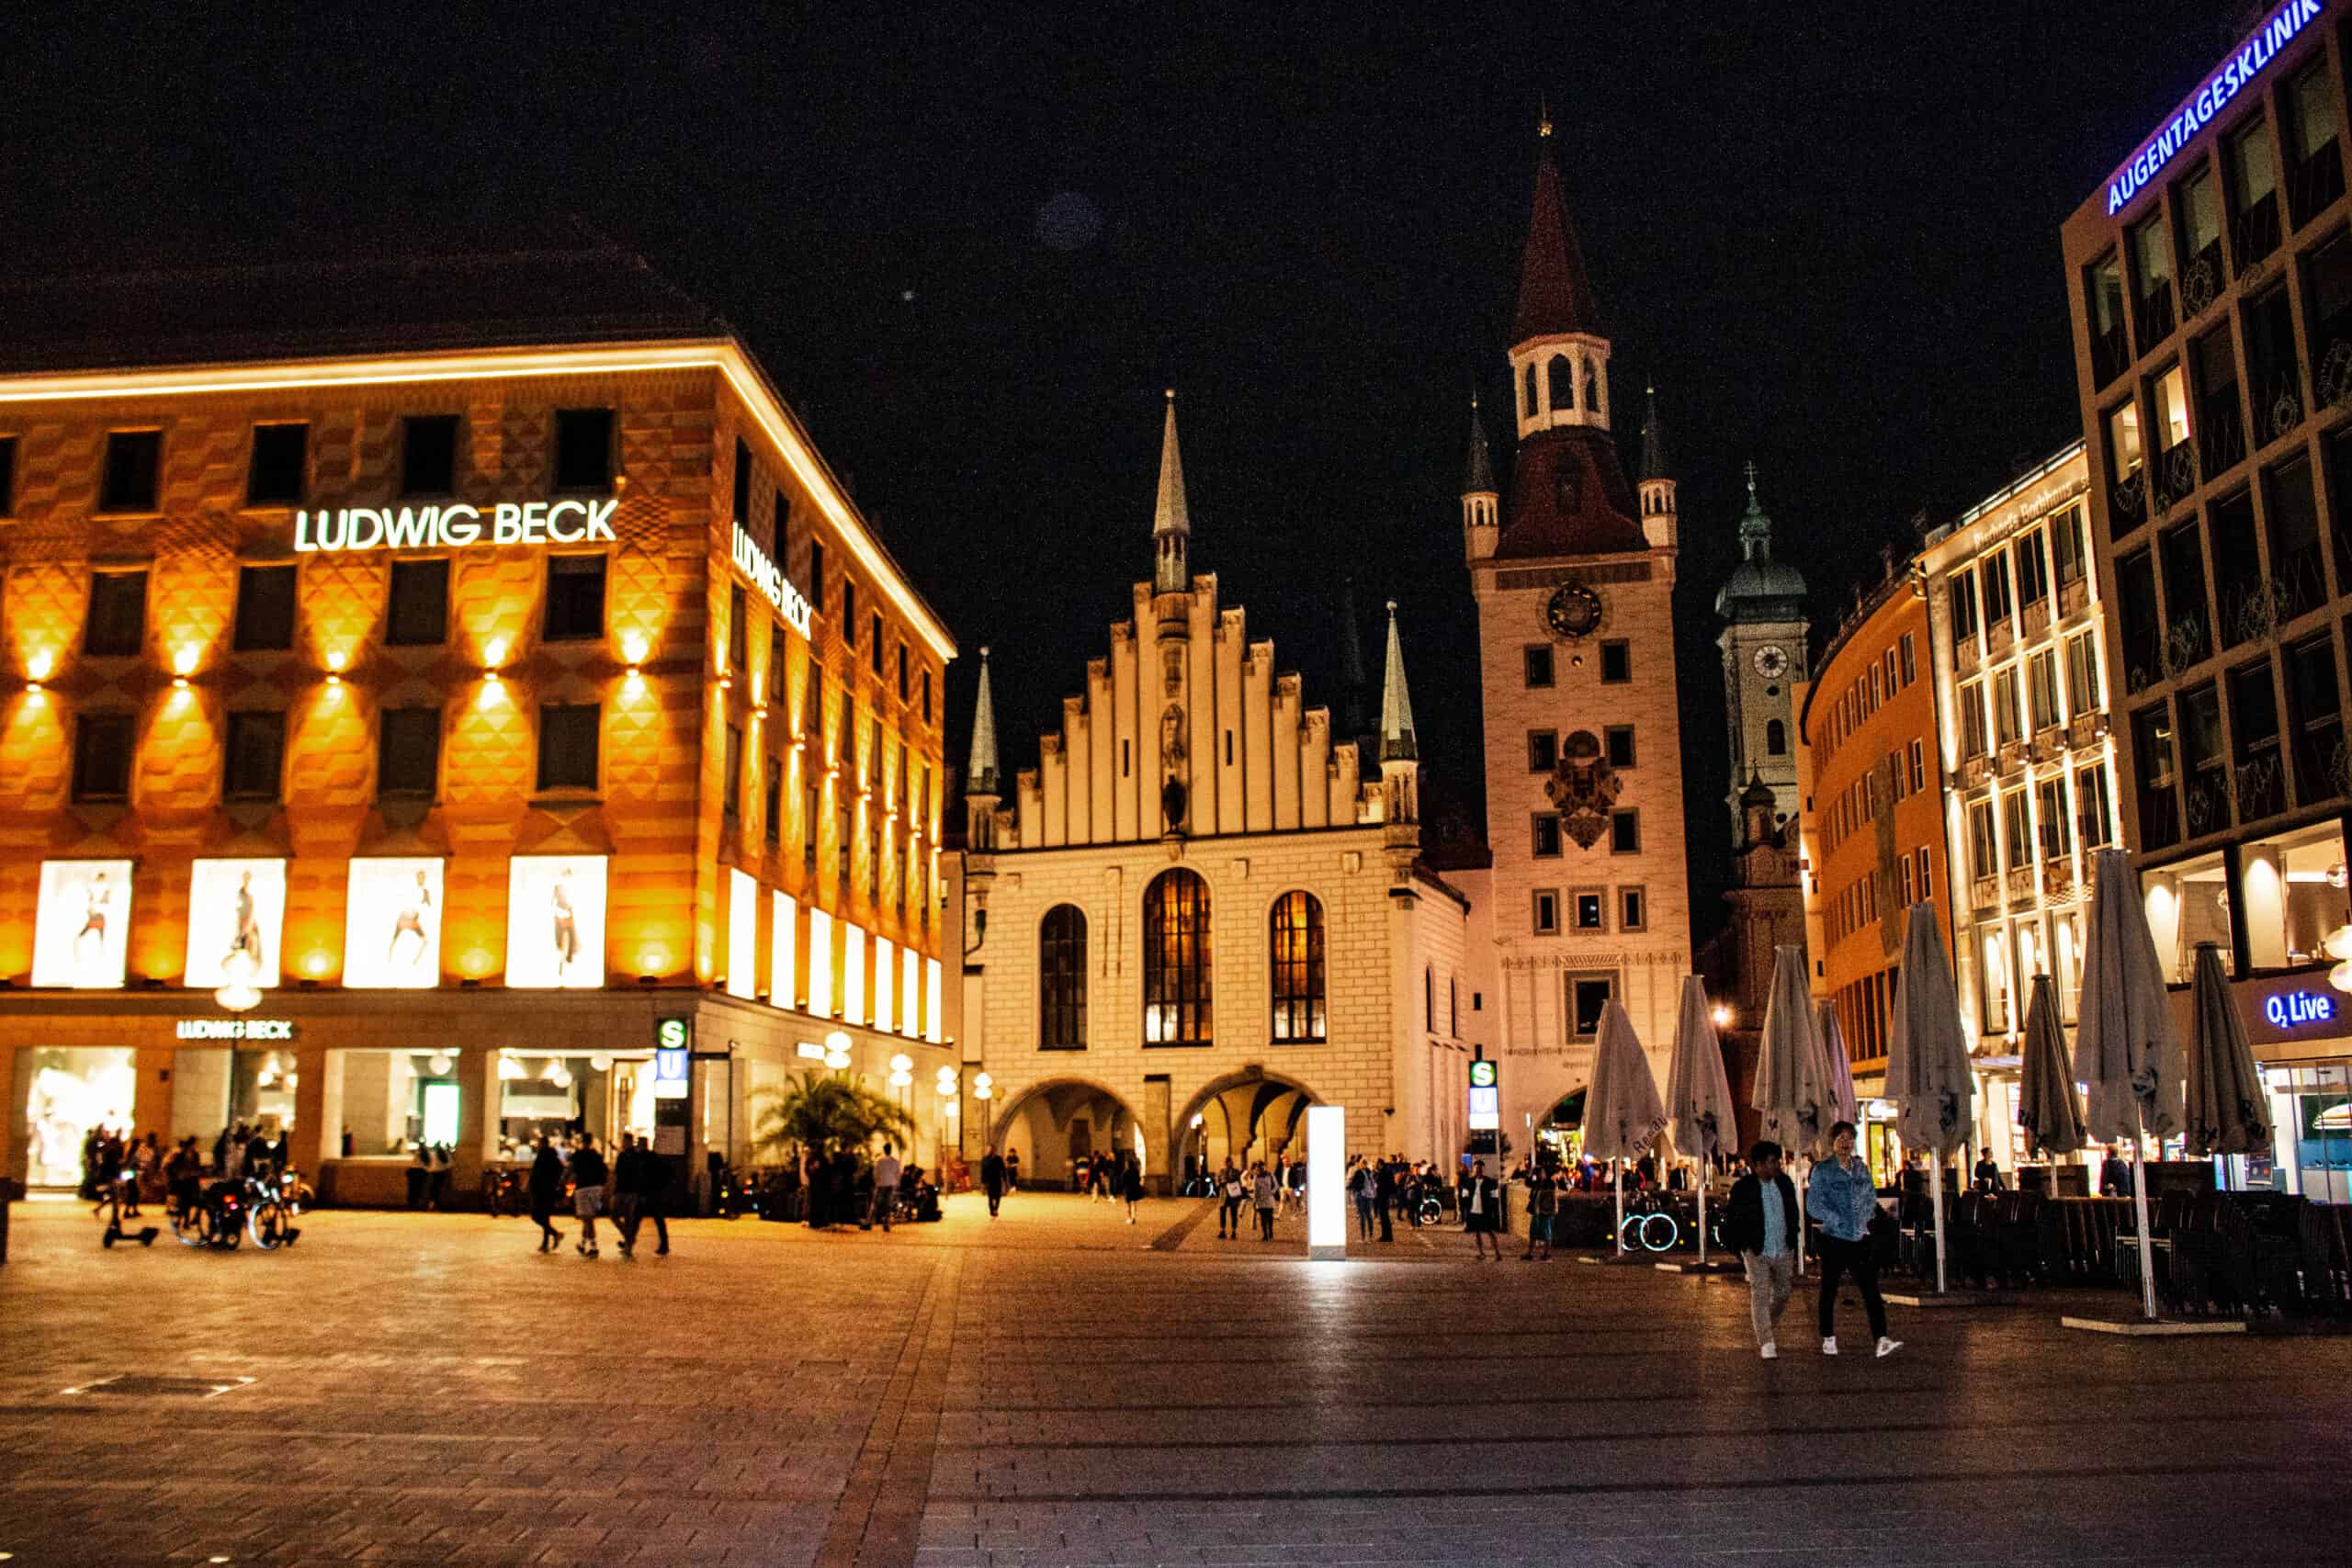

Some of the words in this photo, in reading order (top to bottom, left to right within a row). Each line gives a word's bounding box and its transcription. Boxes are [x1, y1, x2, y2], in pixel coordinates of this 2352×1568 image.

[2107, 0, 2322, 216] AUGENTAGESKLINIK
[294, 504, 481, 552] LUDWIG
[492, 500, 619, 545] BECK
[732, 521, 781, 607] LUDWIG
[781, 578, 813, 641] BECK
[2289, 991, 2330, 1022] Live
[176, 1020, 245, 1039] LUDWIG
[245, 1020, 292, 1039] BECK
[661, 1020, 684, 1048] S
[661, 1052, 683, 1078] U
[1474, 1061, 1495, 1087] S
[1475, 1089, 1493, 1112] U
